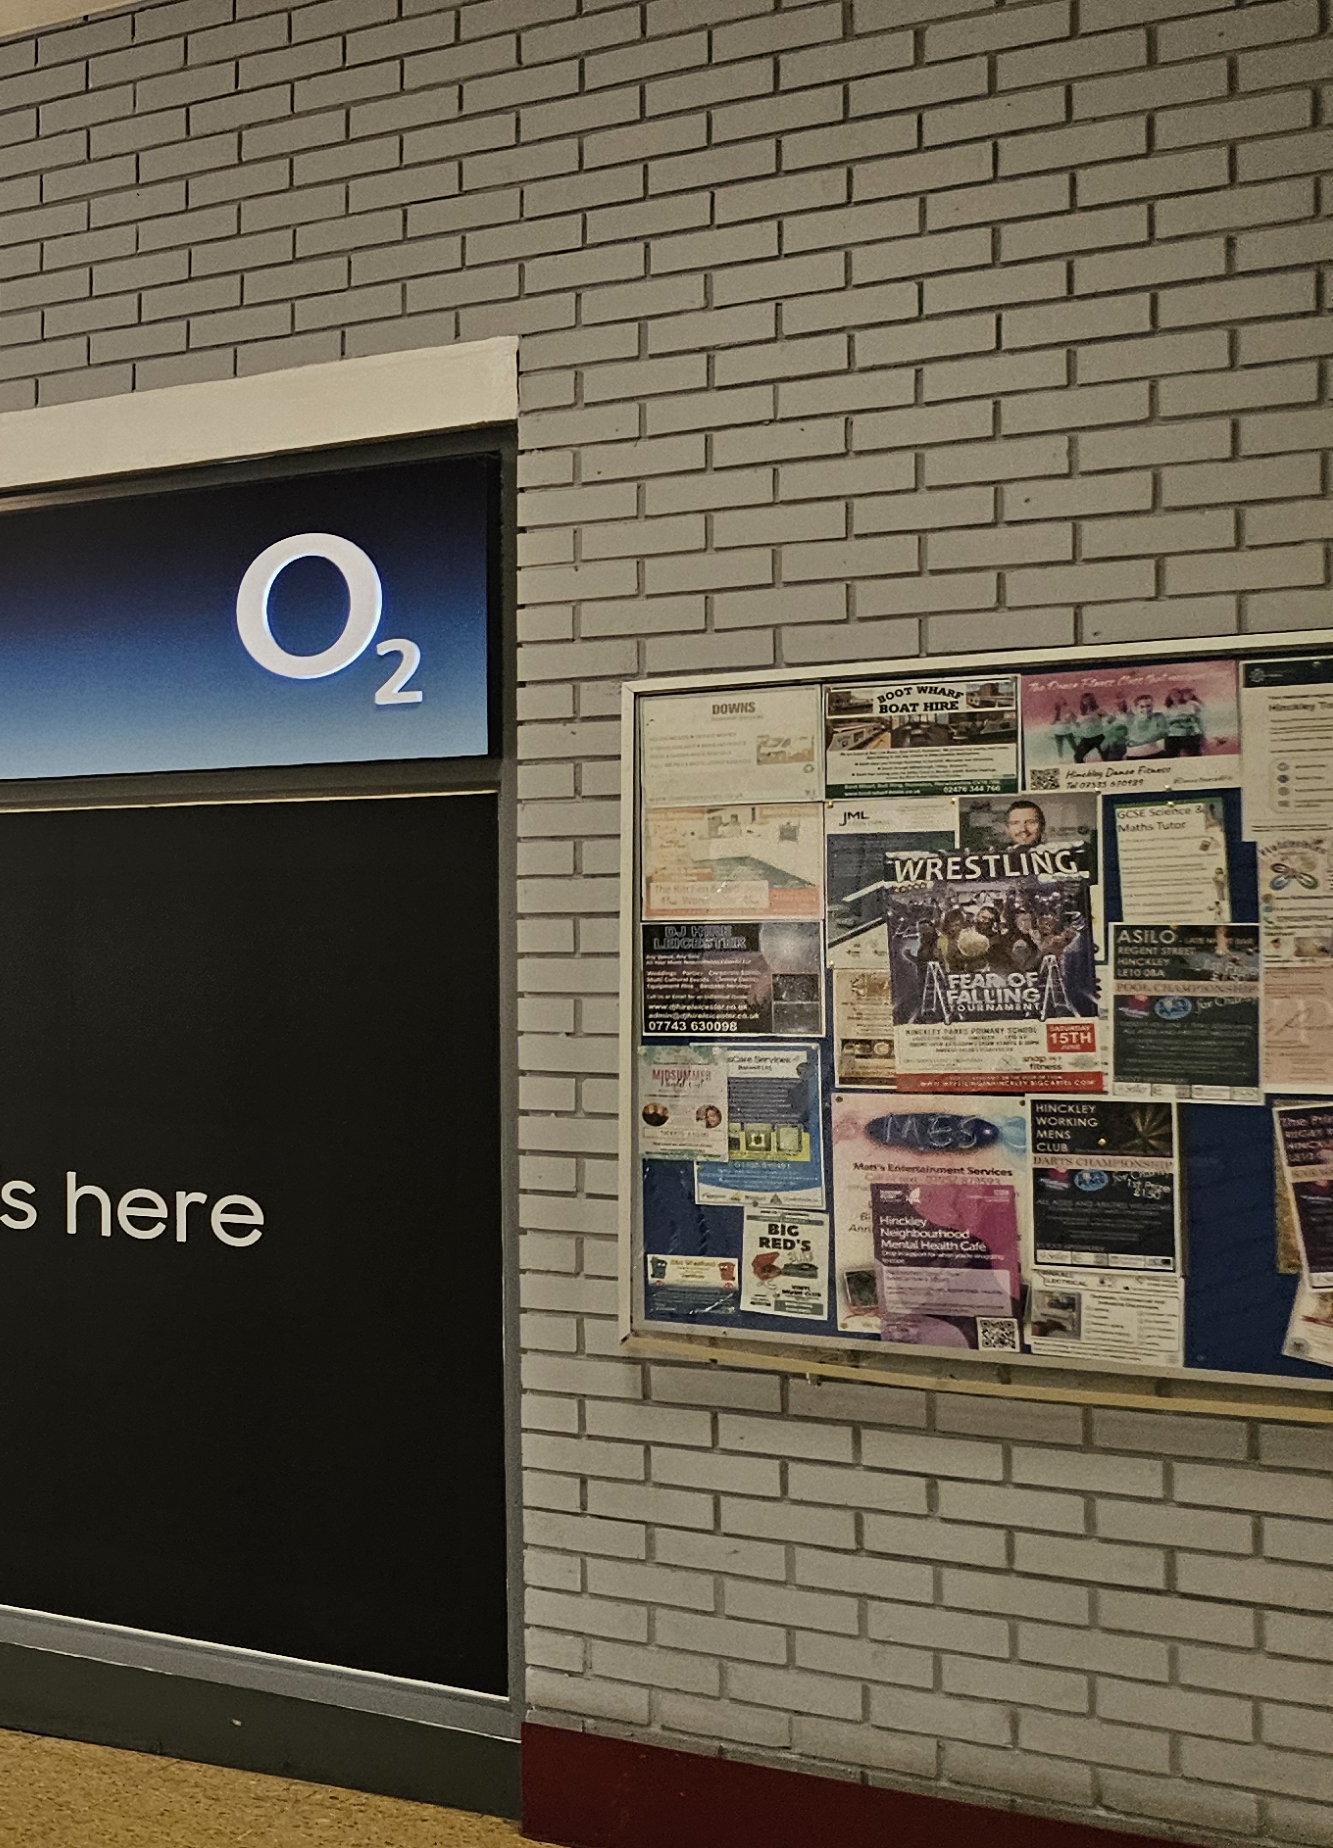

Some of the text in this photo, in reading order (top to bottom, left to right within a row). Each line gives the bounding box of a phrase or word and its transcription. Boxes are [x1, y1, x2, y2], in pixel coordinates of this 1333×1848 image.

[877, 684, 964, 704] BOOT WHARF
[712, 702, 756, 715] DOWNS
[879, 700, 959, 714] BOAT HIRE
[1117, 808, 1147, 819] GCSE
[1149, 805, 1192, 816] Science
[839, 811, 870, 826] JML
[1117, 821, 1187, 832] Maths Tutor
[895, 850, 1078, 882] WRESTLING
[1117, 929, 1177, 944] ASILO
[1117, 946, 1158, 955] REGENT
[1117, 958, 1171, 966] HINCKLEY
[946, 972, 1039, 989] FEAR OF
[949, 1003, 1040, 1012] TOURNAMENT
[648, 1021, 738, 1031] 07743 630098
[1049, 1031, 1093, 1044] 15TH
[1029, 1062, 1063, 1070] fitness
[652, 1068, 712, 1082] MIDSUMMER
[1035, 1104, 1096, 1113] HINCKLEY
[1036, 1117, 1099, 1127] WORKING
[1036, 1130, 1071, 1140] MENS
[1036, 1143, 1069, 1152] CLUB
[1033, 1156, 1174, 1169] DARTS CHAMPIONSHIP
[887, 1163, 965, 1175] Entertainment
[966, 1167, 1013, 1177] Services
[67, 1170, 264, 1247] here
[880, 1216, 927, 1227] Hinckley
[768, 1224, 799, 1236] BIG
[880, 1228, 970, 1239] Neighbourhood
[759, 1237, 812, 1251] RED'S
[881, 1239, 987, 1251] Mental Health Café
